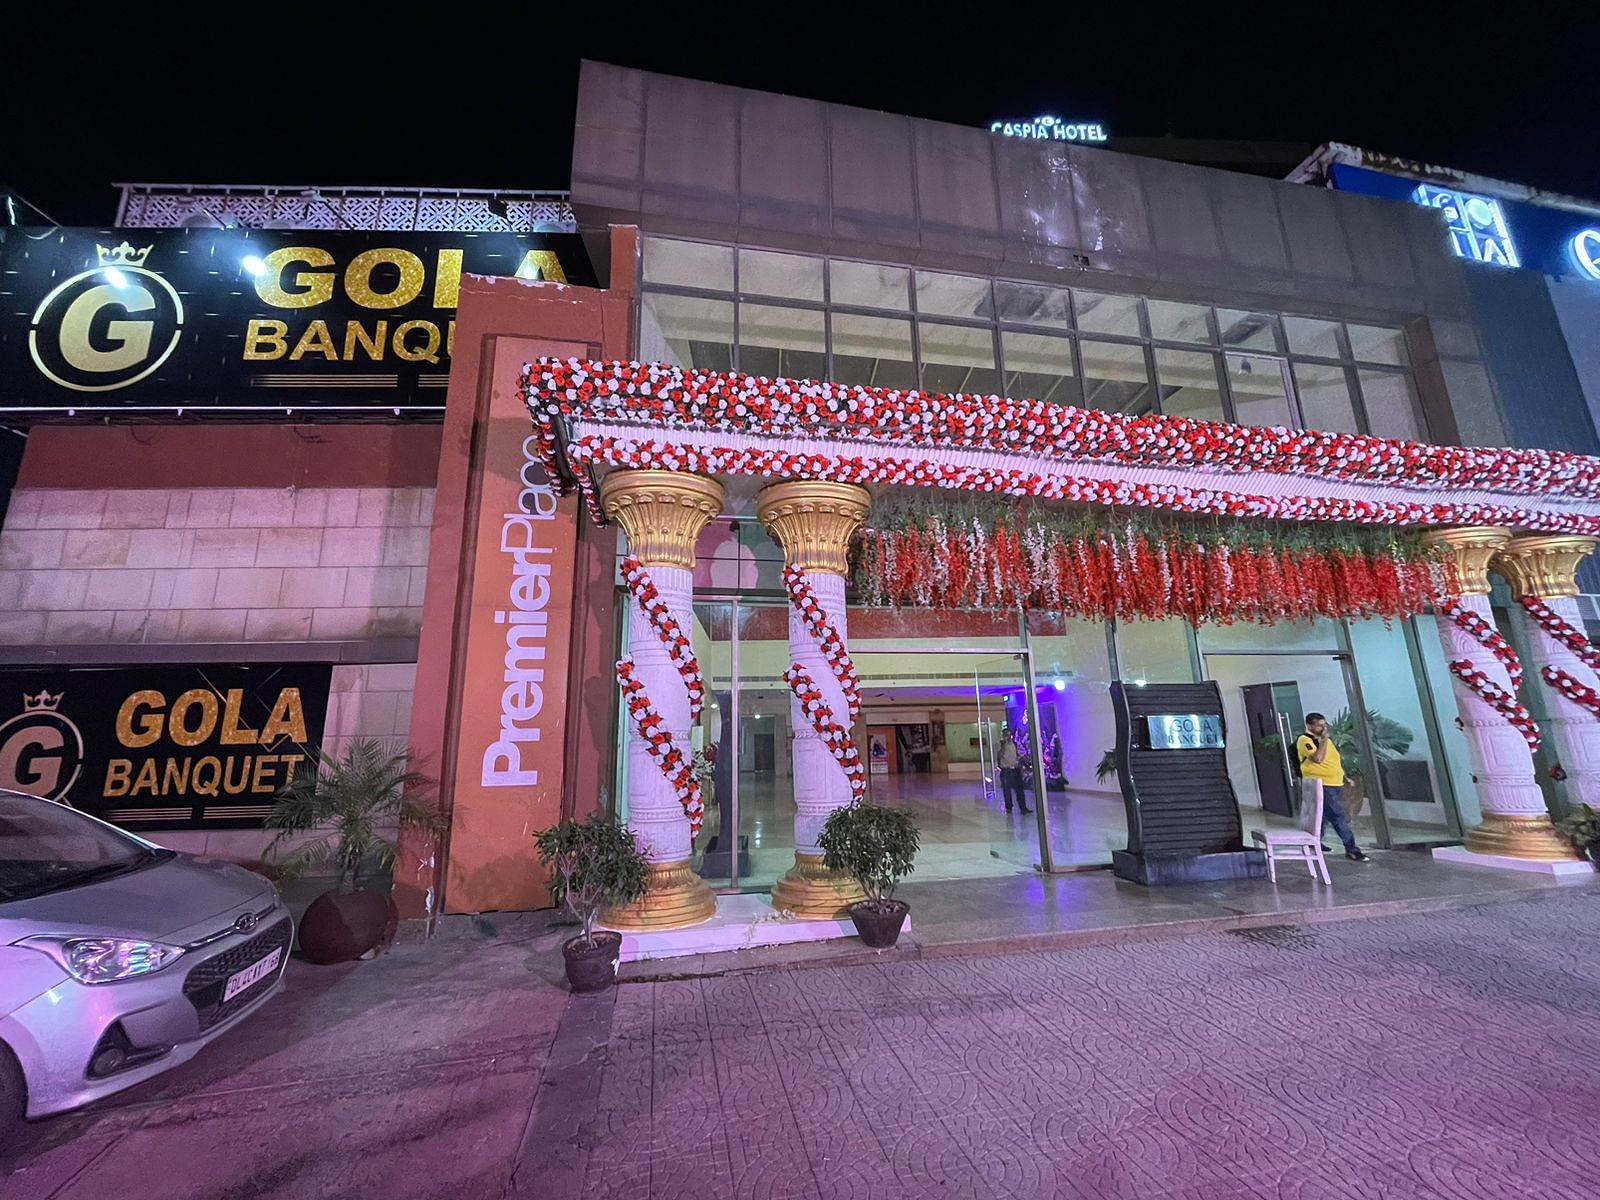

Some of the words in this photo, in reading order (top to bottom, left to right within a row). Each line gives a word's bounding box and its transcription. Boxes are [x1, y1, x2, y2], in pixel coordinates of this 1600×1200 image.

[991, 122, 1049, 140] CASPIA
[1053, 123, 1108, 142] HOTEL
[242, 318, 456, 364] BANQ
[115, 687, 308, 749] GOLA
[1170, 718, 1214, 733] GOA
[102, 754, 305, 798] BANQUET
